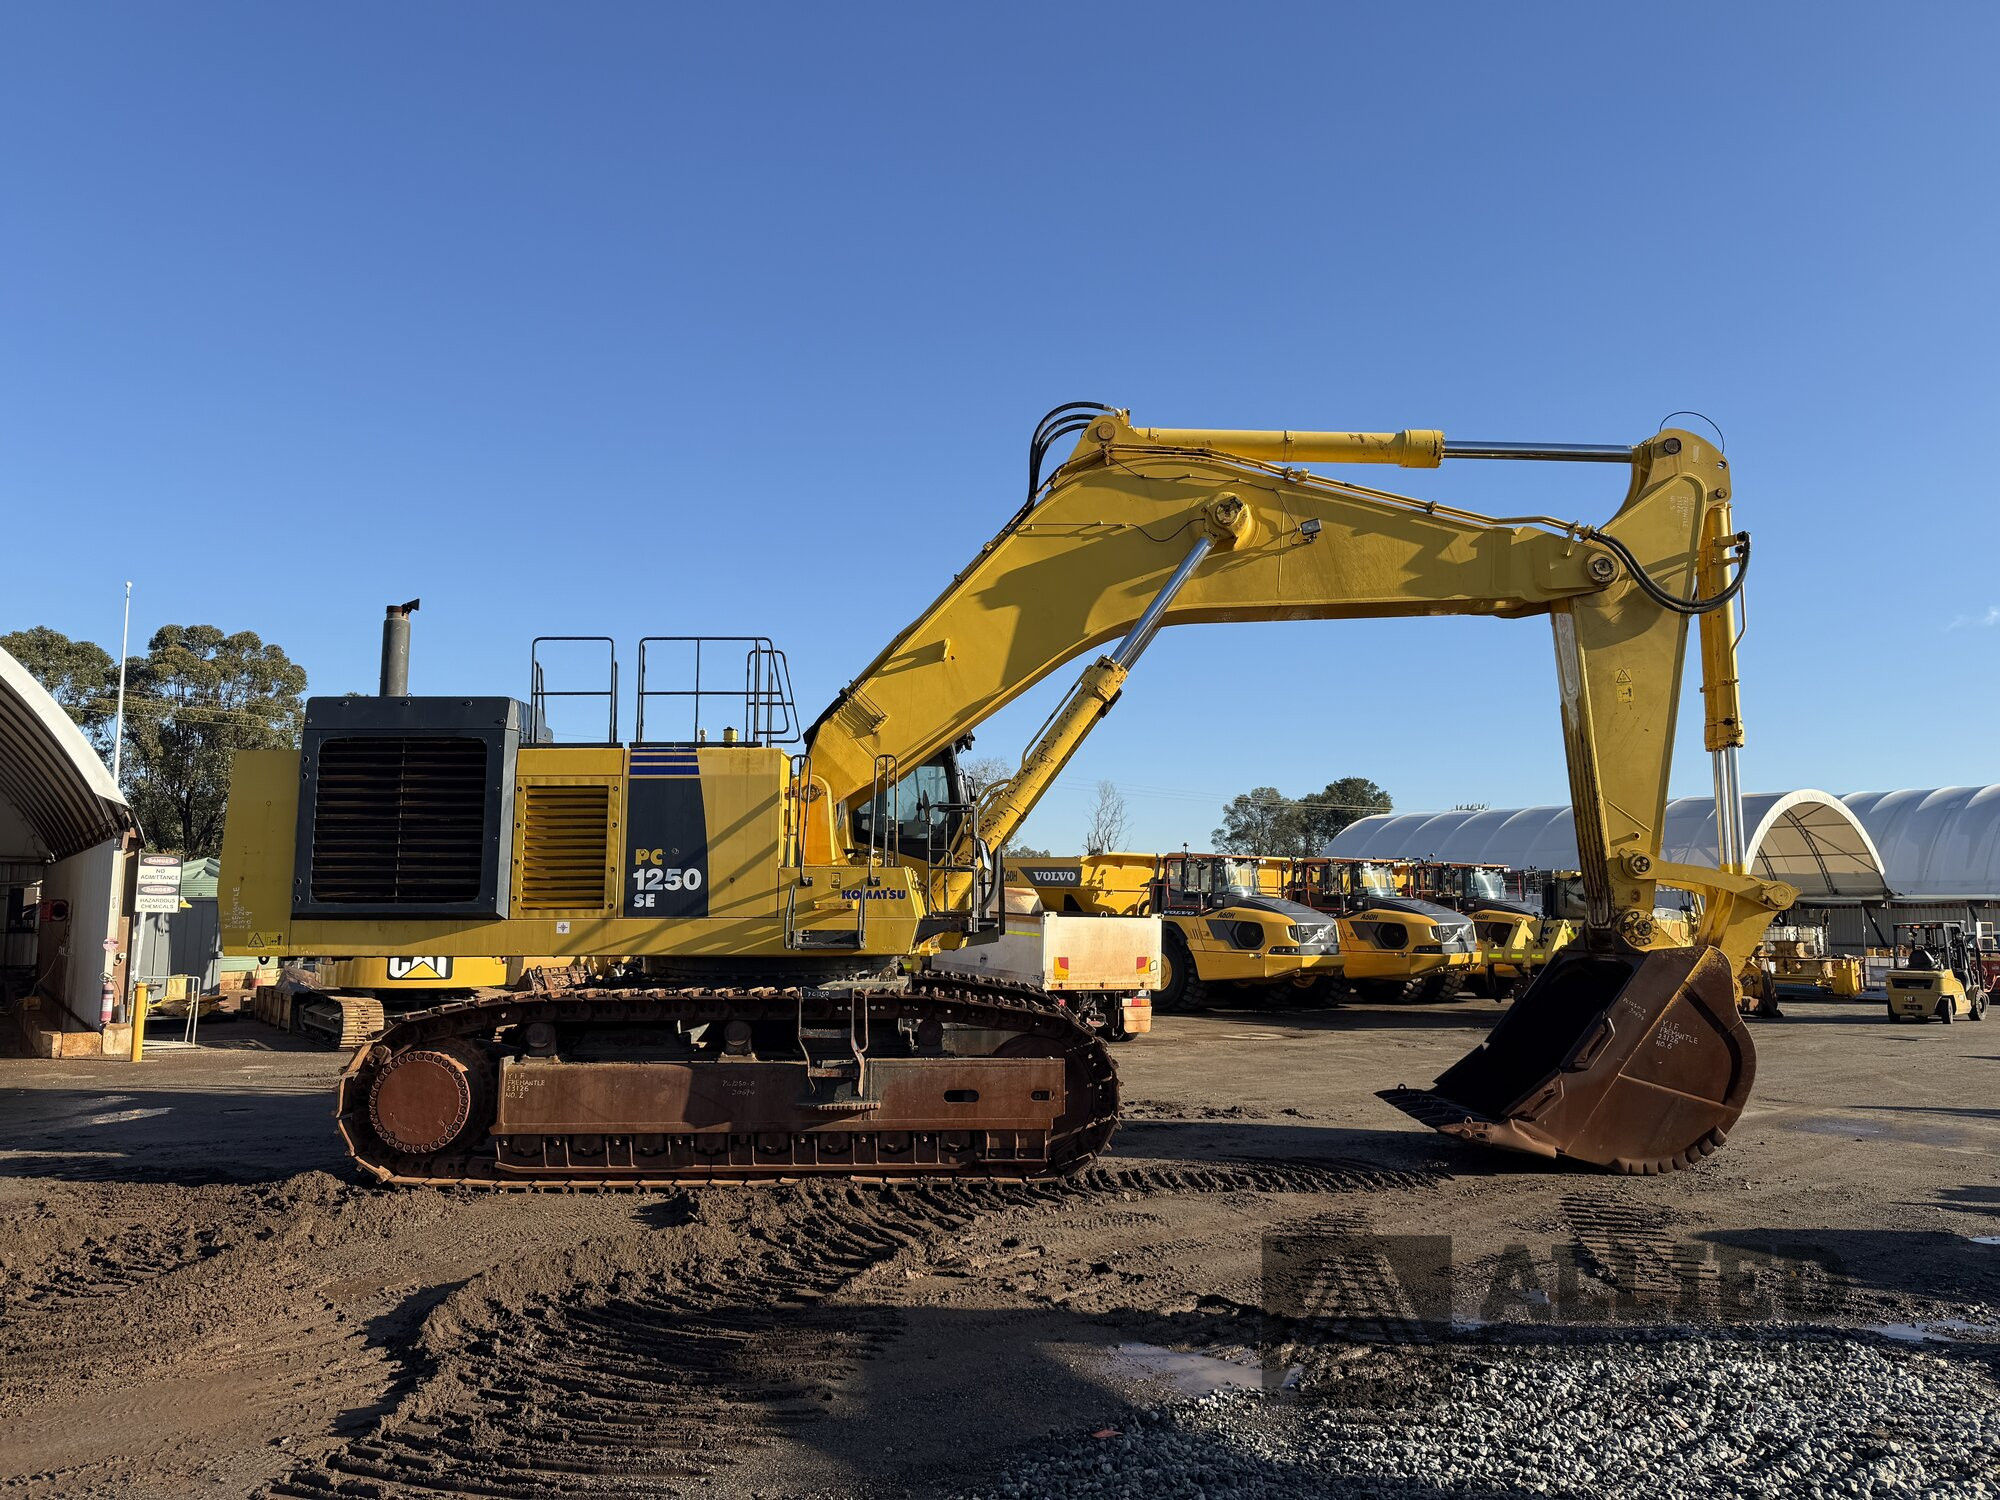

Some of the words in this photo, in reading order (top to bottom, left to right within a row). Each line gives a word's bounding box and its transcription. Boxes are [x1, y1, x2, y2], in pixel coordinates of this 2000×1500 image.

[635, 849, 663, 866] PC
[633, 868, 702, 891] 1250
[1033, 871, 1076, 881] VOLVO
[634, 894, 655, 907] SE
[1659, 1027, 1698, 1045] FREMANTLE
